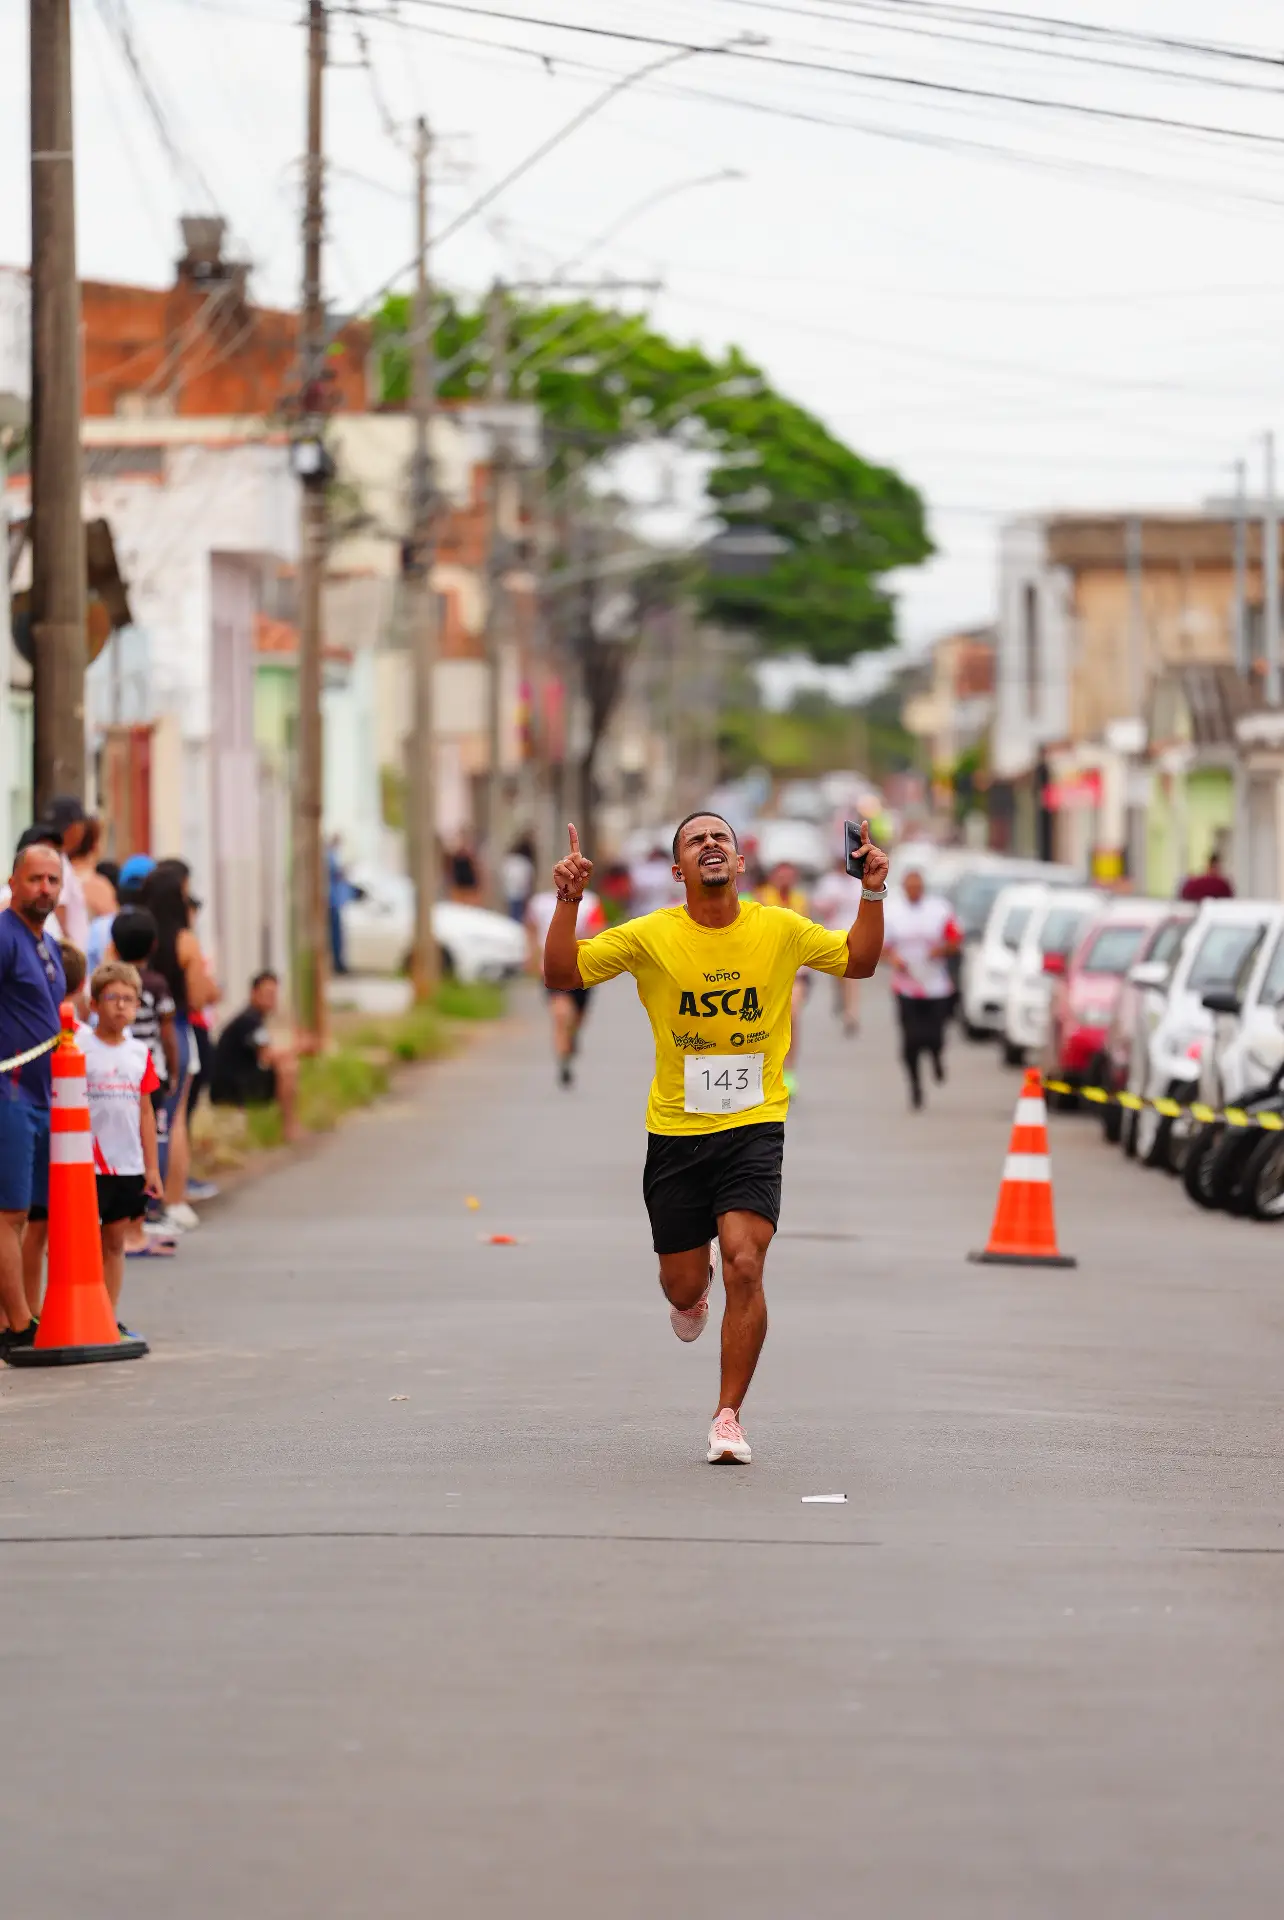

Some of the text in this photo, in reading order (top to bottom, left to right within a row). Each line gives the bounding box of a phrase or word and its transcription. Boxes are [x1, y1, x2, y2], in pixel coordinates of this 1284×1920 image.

[679, 987, 758, 1017] ASCA
[739, 1006, 763, 1023] RUN
[701, 1068, 749, 1091] 143
